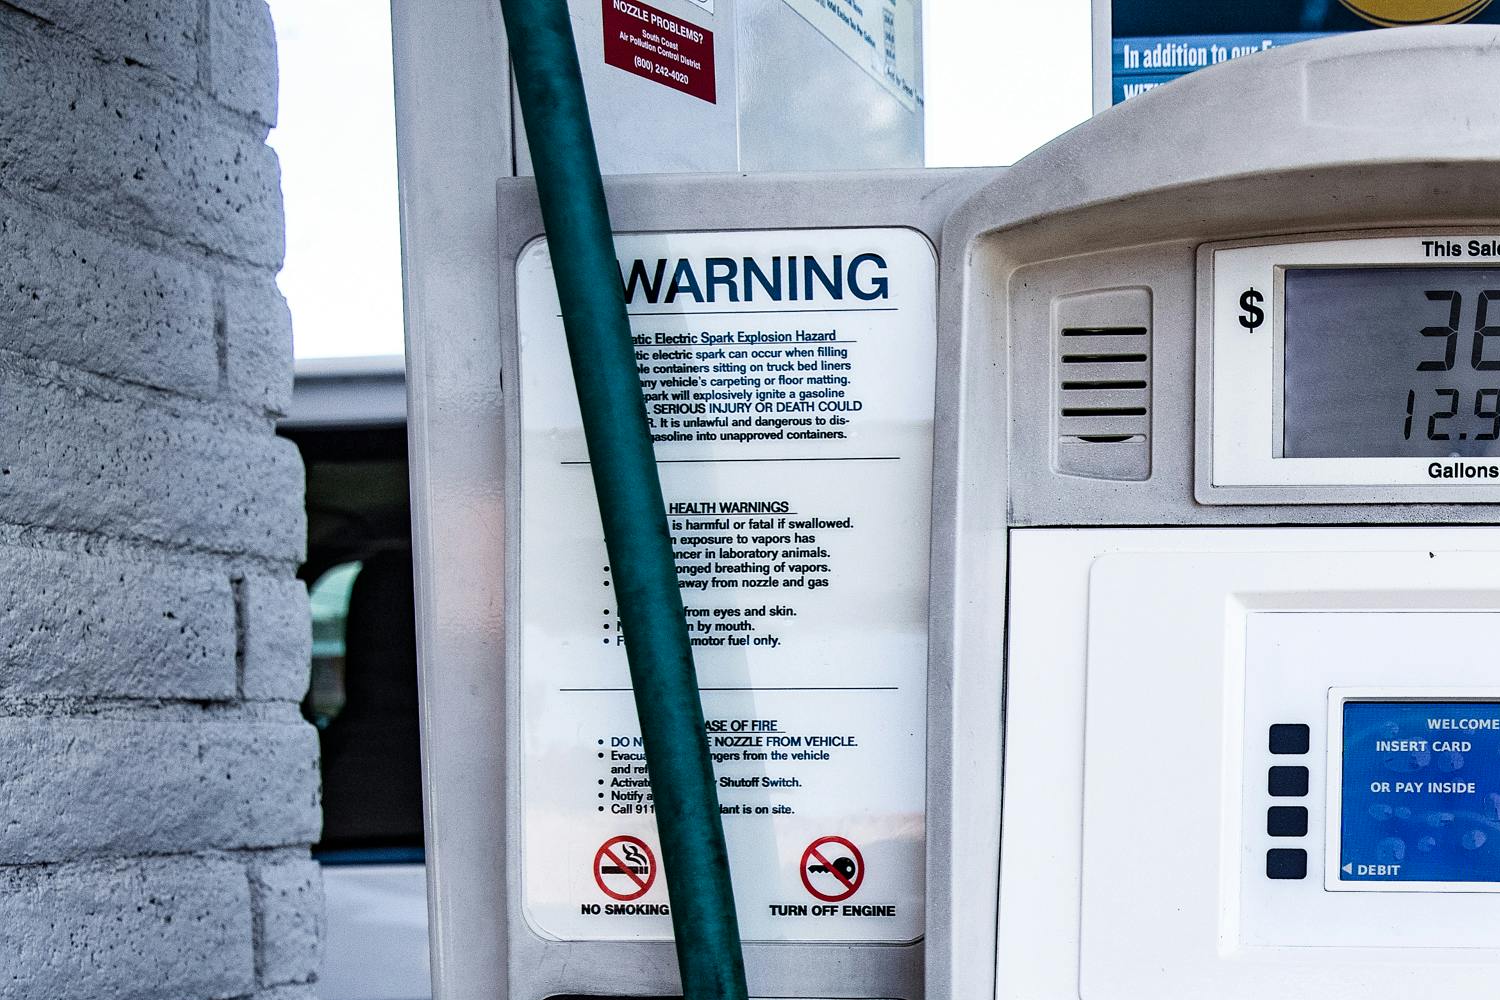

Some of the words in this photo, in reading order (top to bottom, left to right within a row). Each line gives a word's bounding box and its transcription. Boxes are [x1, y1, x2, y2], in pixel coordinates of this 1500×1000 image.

[613, 0, 649, 22] NOZZLE
[650, 14, 704, 44] PROBLEMS?
[642, 29, 660, 43] South
[661, 37, 678, 51] Coast
[620, 31, 628, 42] Air
[629, 34, 657, 52] Pollution
[657, 46, 680, 61] Control
[680, 54, 701, 70] District
[1124, 44, 1139, 68] In
[1143, 43, 1207, 68] addition
[1211, 44, 1227, 65] to
[634, 55, 653, 73] (800)
[655, 64, 689, 85] 242-4020
[1422, 240, 1462, 257] This
[617, 252, 889, 304] WARNING
[1238, 286, 1264, 334] $
[656, 333, 697, 345] Electric
[701, 331, 734, 345] Spark
[737, 331, 792, 344] Explosion
[796, 330, 836, 341] Hazard
[652, 349, 692, 361] electric
[695, 349, 725, 362] spark
[729, 350, 748, 359] can
[751, 349, 782, 359] occur
[785, 347, 814, 358] when
[817, 347, 848, 360] filling
[653, 403, 706, 415] SERIOUS
[709, 402, 752, 414] INJURY
[755, 402, 773, 413] OR
[776, 401, 815, 413] DEATH
[818, 400, 863, 412] COULD
[1428, 462, 1499, 479] Gallons
[669, 502, 716, 513] HEALTH
[719, 501, 789, 513] WARNINGS
[672, 519, 683, 530] is
[686, 519, 730, 531] harmful
[733, 521, 746, 530] or
[749, 518, 774, 529] fatal
[777, 518, 786, 529] if
[788, 517, 854, 529] swallowed.
[1427, 718, 1500, 730] WELCOME
[714, 736, 763, 747] NOZZLE
[766, 736, 802, 747] FROM
[805, 736, 858, 747] VEHICLE.
[1376, 741, 1428, 752] INSERT
[1432, 741, 1472, 752] CARD
[1370, 782, 1391, 793] OR
[1396, 782, 1423, 793] PAY
[1428, 782, 1476, 793] INSIDE
[1357, 865, 1401, 876] DEBIT
[581, 905, 601, 915] NO
[605, 904, 669, 916] SMOKING
[769, 905, 808, 916] TURN
[811, 905, 839, 916] OFF
[842, 905, 896, 916] ENGINE
